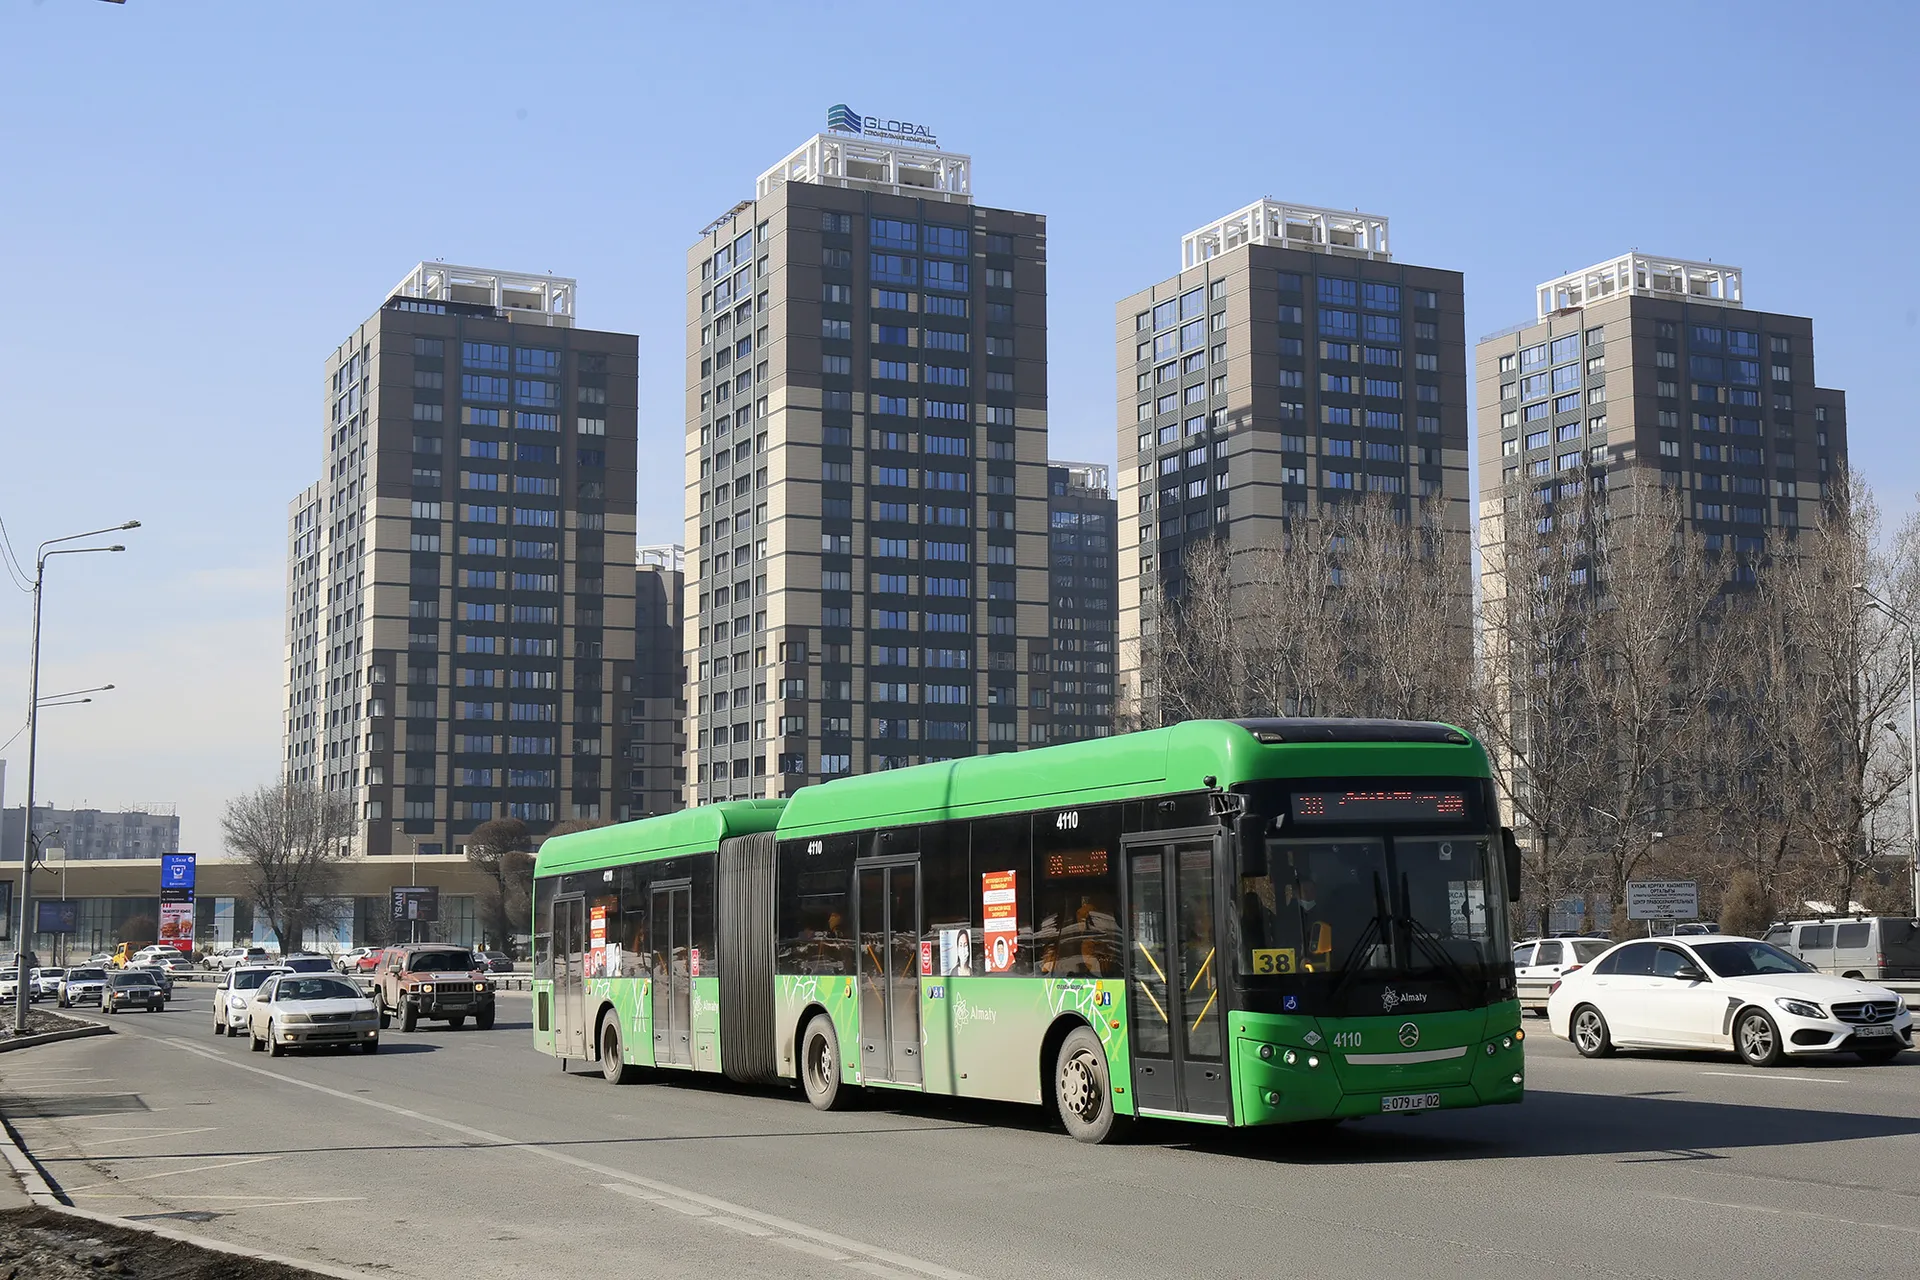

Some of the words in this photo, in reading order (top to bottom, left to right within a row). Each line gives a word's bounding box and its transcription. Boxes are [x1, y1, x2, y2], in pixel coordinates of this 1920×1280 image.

[864, 116, 936, 138] GLOBAL
[1056, 811, 1078, 829] 4110
[807, 840, 822, 855] 4110
[1259, 954, 1290, 973] 38
[1400, 993, 1427, 1003] Almaty
[970, 1005, 996, 1024] Almaty
[1333, 1032, 1361, 1047] 4110
[1392, 1097, 1410, 1109] 079
[1412, 1098, 1423, 1107] LF
[1427, 1095, 1439, 1106] 02
